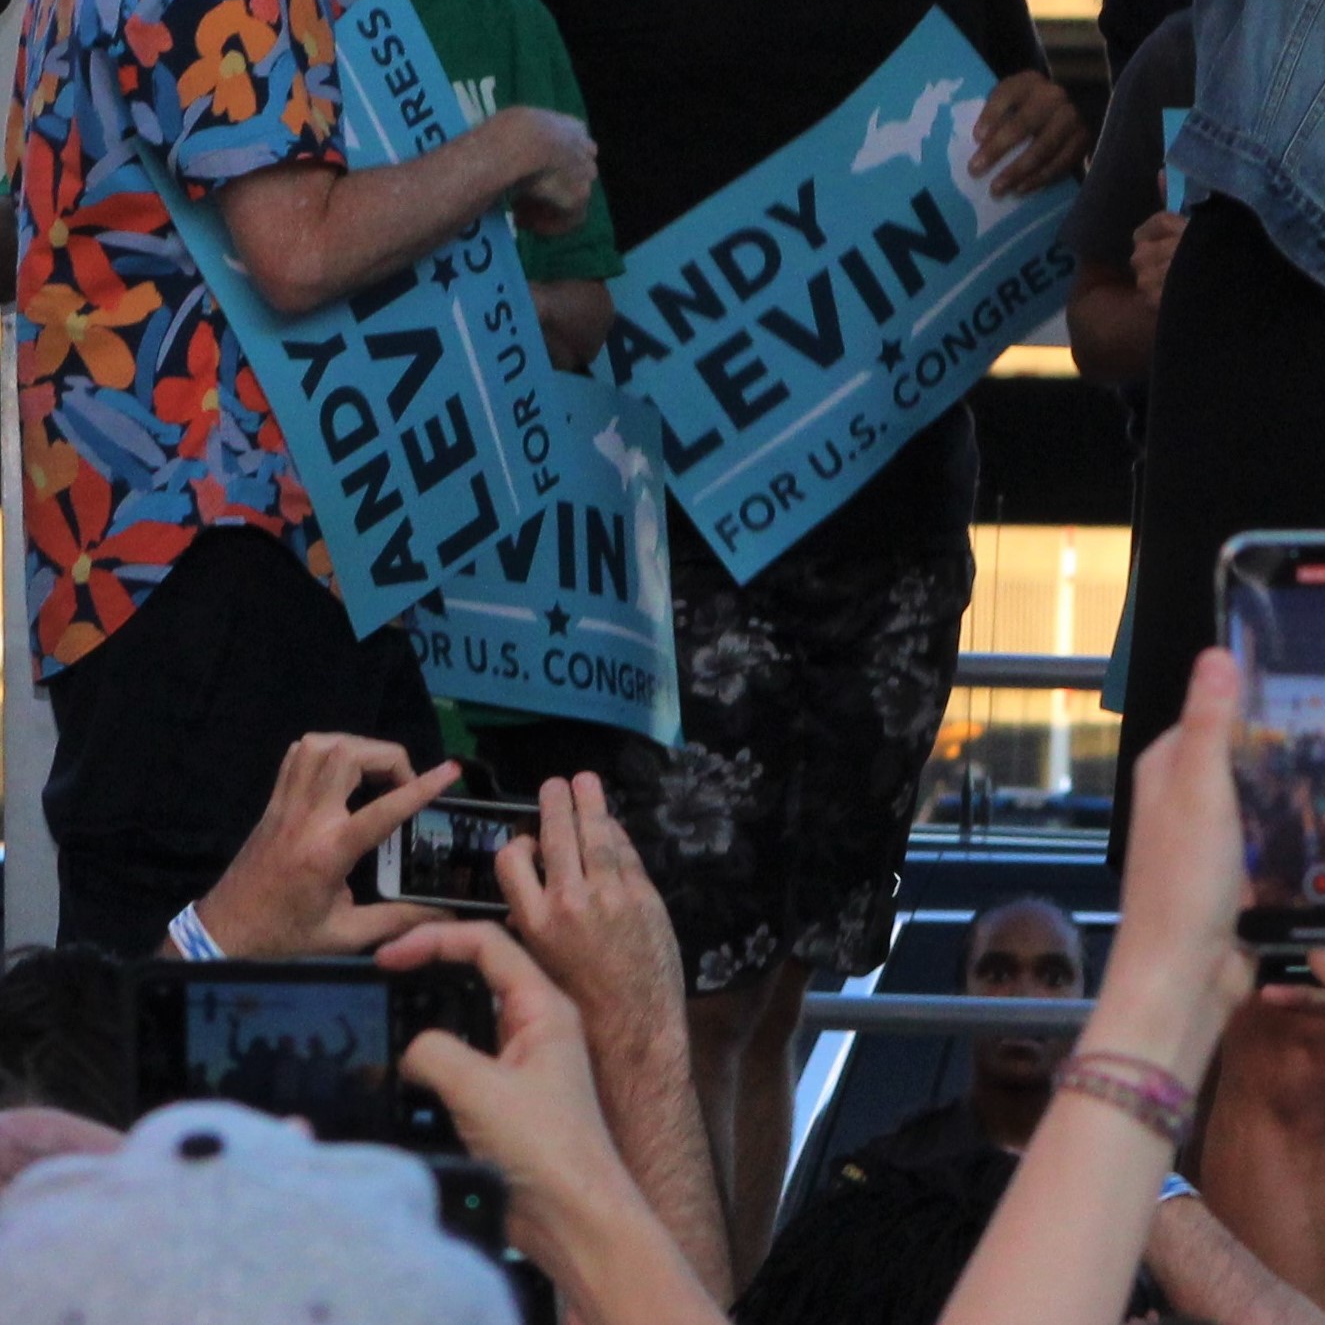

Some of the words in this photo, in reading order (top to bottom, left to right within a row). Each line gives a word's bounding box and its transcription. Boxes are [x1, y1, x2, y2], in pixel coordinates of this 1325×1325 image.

[484, 282, 527, 384] U.S.
[607, 177, 829, 386] ANDY
[644, 186, 961, 476] LEVIN
[714, 472, 806, 553] FOR
[807, 414, 888, 481] U.S.
[892, 243, 1076, 412] CONGRES
[281, 331, 429, 588] ANDY
[349, 263, 500, 569] LEVI
[513, 388, 561, 496] FOR
[464, 634, 530, 681] U.S.
